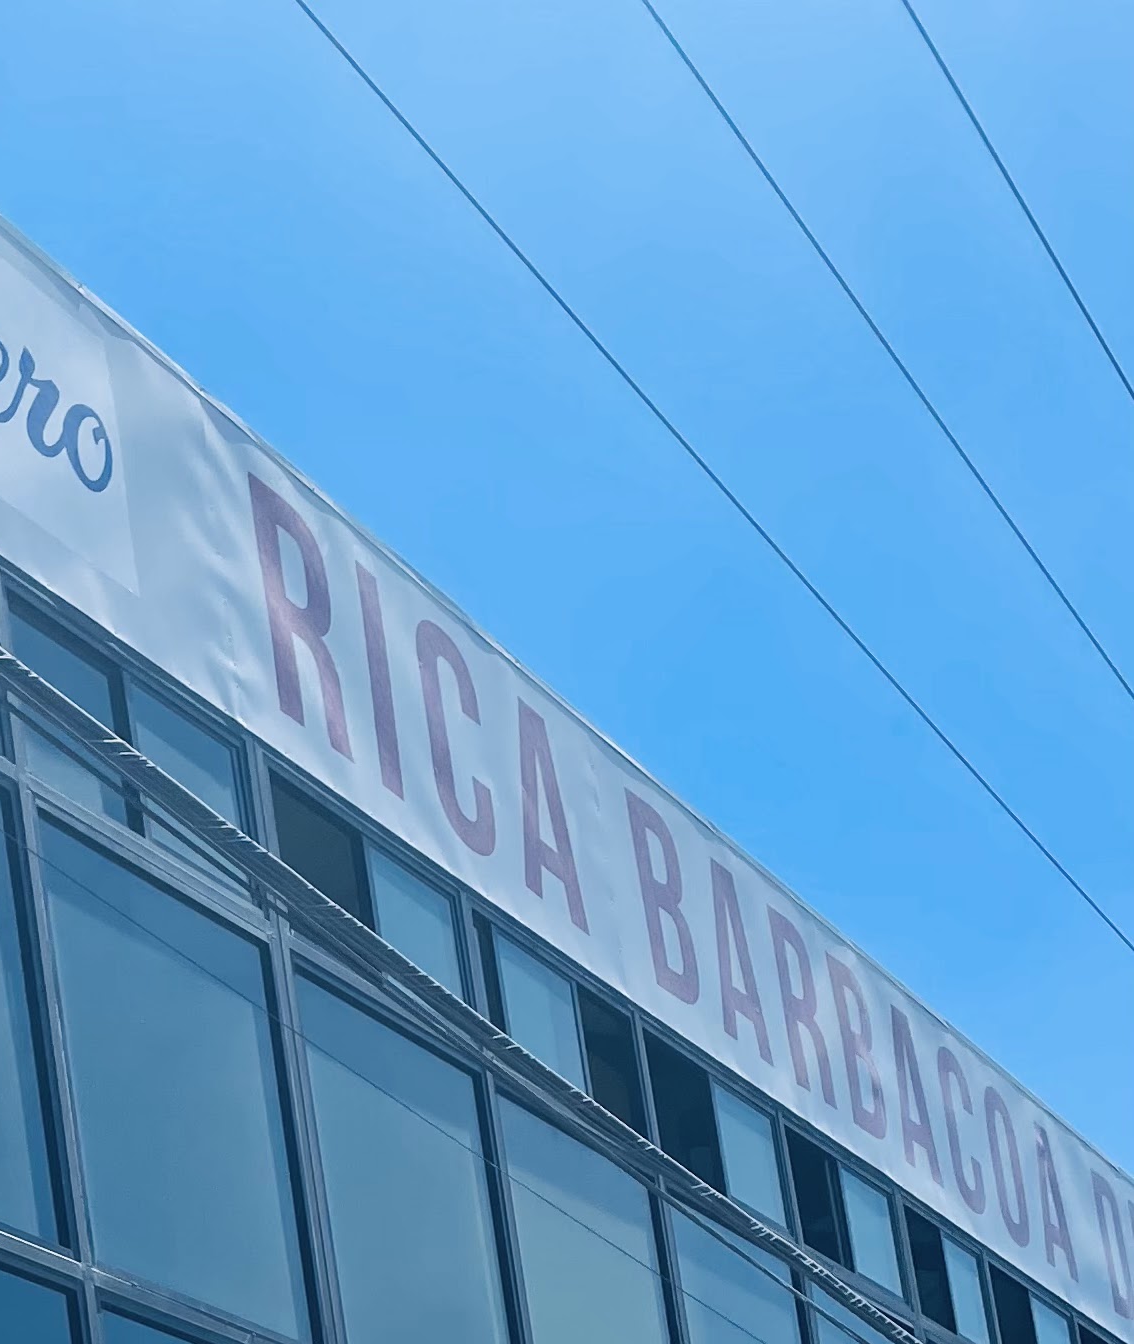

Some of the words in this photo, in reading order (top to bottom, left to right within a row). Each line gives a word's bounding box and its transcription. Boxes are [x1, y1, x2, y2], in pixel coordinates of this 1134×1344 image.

[248, 472, 589, 936] RICA
[624, 787, 1080, 1284] BARBACOA
[1090, 1168, 1134, 1321] D
